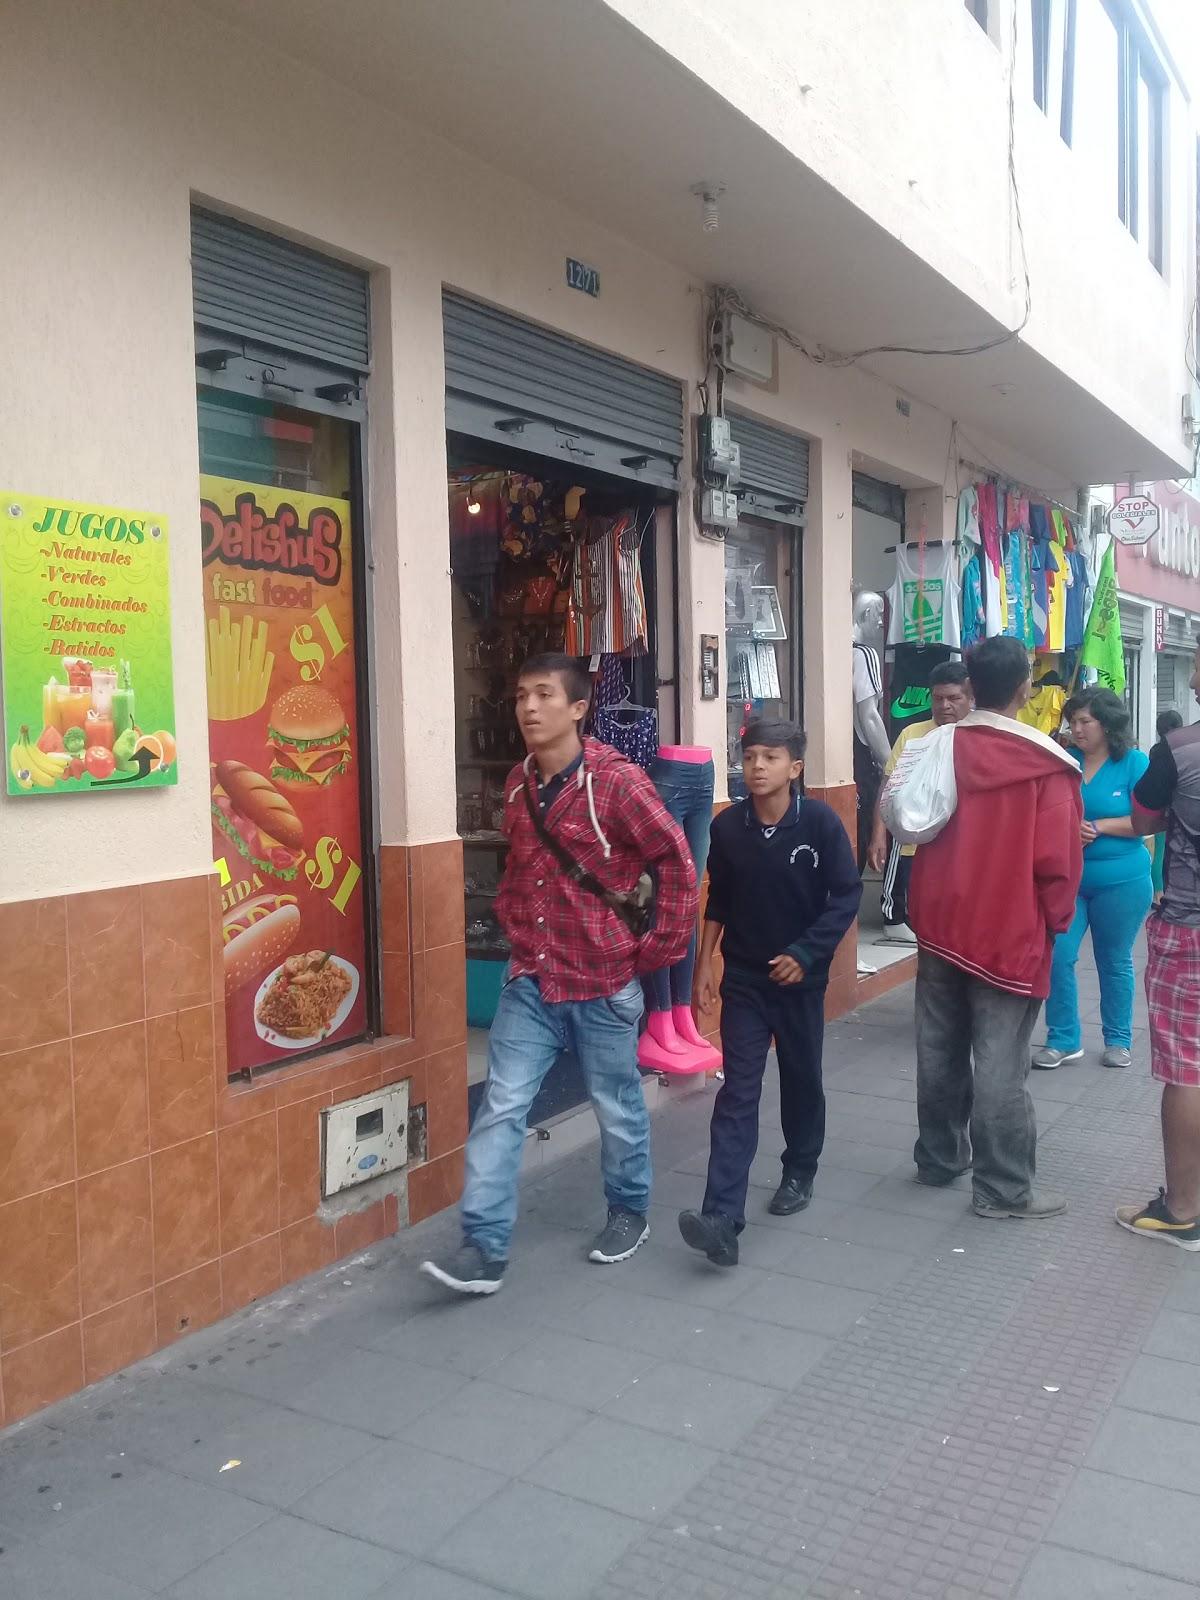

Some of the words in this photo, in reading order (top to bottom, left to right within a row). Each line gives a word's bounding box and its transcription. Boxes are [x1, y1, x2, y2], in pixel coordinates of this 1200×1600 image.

[1118, 501, 1149, 512] STOP
[33, 507, 146, 545] JUGOS
[212, 572, 256, 603] fast
[262, 578, 313, 608] food
